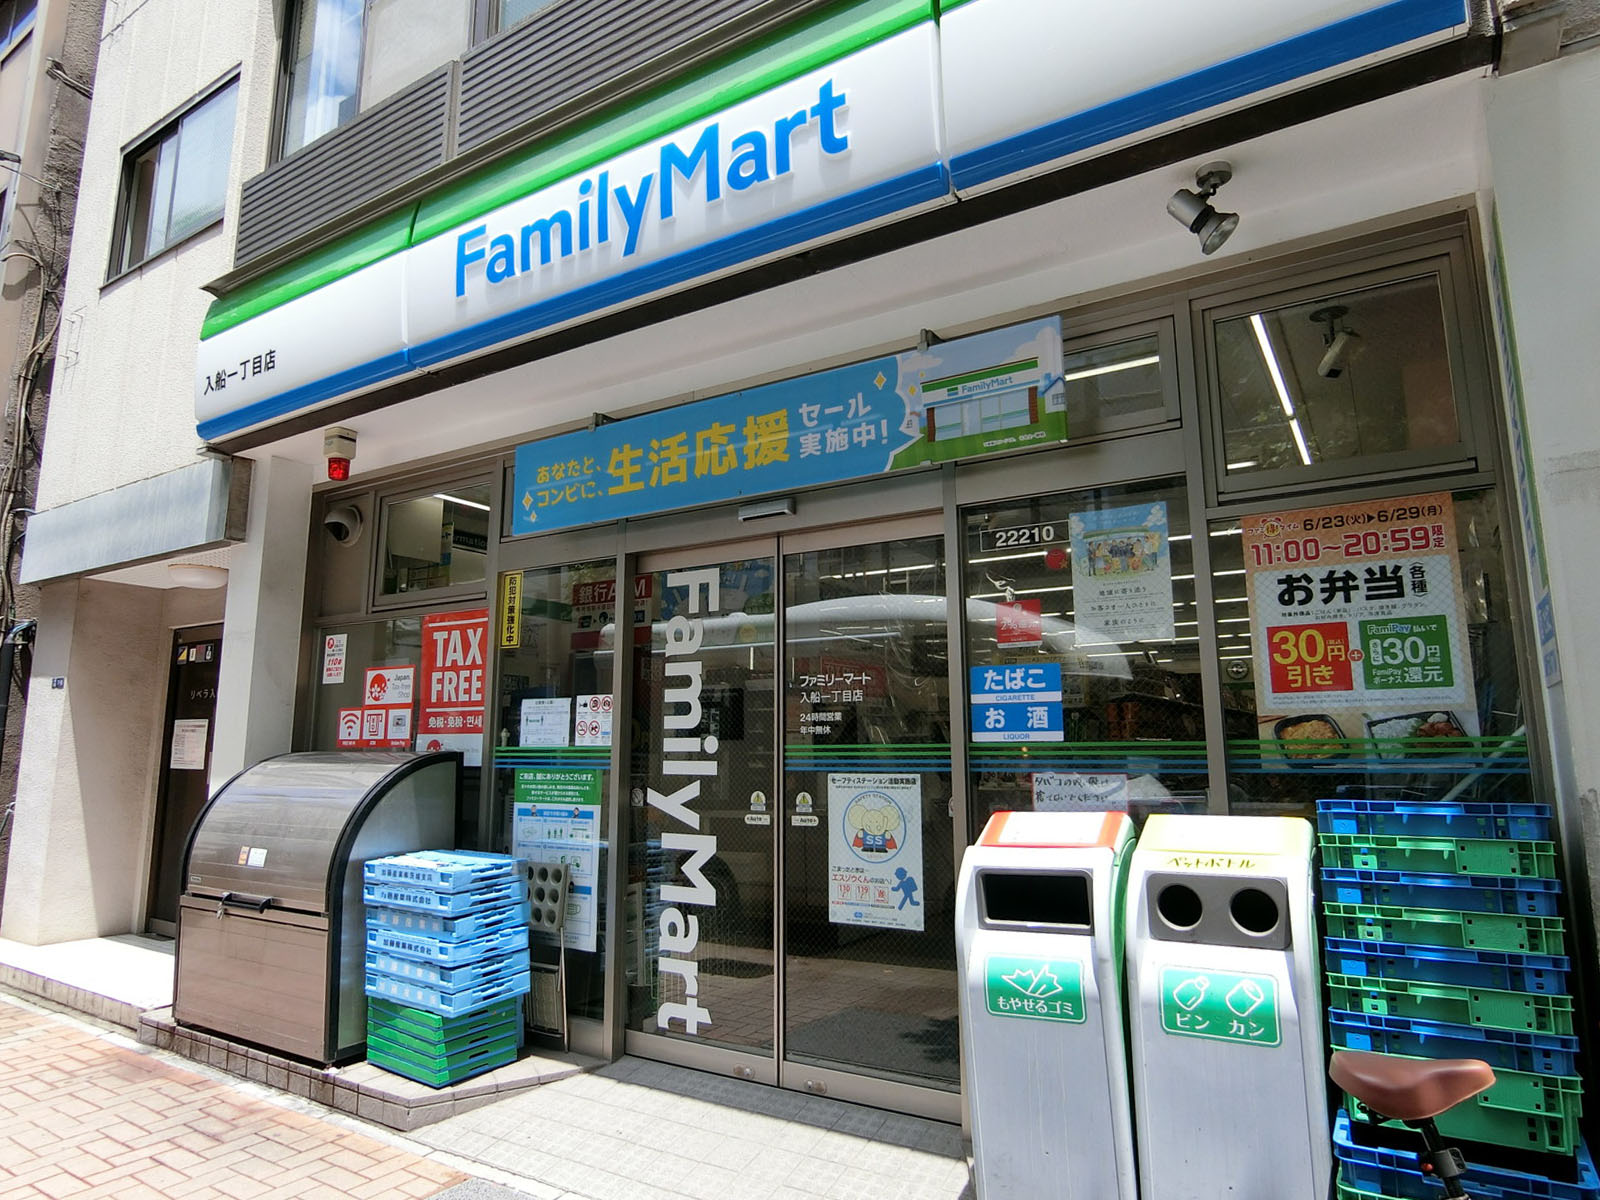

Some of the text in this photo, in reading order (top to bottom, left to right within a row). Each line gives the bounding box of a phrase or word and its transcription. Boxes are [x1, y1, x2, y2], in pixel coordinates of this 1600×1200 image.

[455, 79, 849, 297] FamilyMart
[203, 349, 276, 396] 入船一丁目店
[961, 376, 1013, 394] FamilyMart
[799, 392, 872, 428] セール
[799, 418, 888, 459] 実施中!
[607, 408, 790, 496] 生活応援
[995, 526, 1055, 547] 22210
[1431, 525, 1446, 549] 限定
[1277, 564, 1406, 606] お弁当
[505, 576, 518, 644] 防犯対策強化中
[1367, 623, 1411, 636] FamiPay
[433, 627, 483, 668] TAX
[800, 672, 872, 687] ファミリーマート
[984, 669, 1047, 691] たばこ
[1286, 664, 1335, 688] 引き
[1372, 668, 1402, 676] FamiPay
[1403, 666, 1443, 683] 還元
[431, 669, 483, 703] FREE
[800, 689, 863, 704] 入船一丁目店
[800, 712, 843, 723] 24時間営業
[800, 725, 832, 735] 年中無休
[647, 566, 720, 1035] FamilyMart
[866, 835, 883, 845] SS
[996, 996, 1075, 1016] もやせるゴミ
[1175, 1013, 1265, 1036] ビン カン
